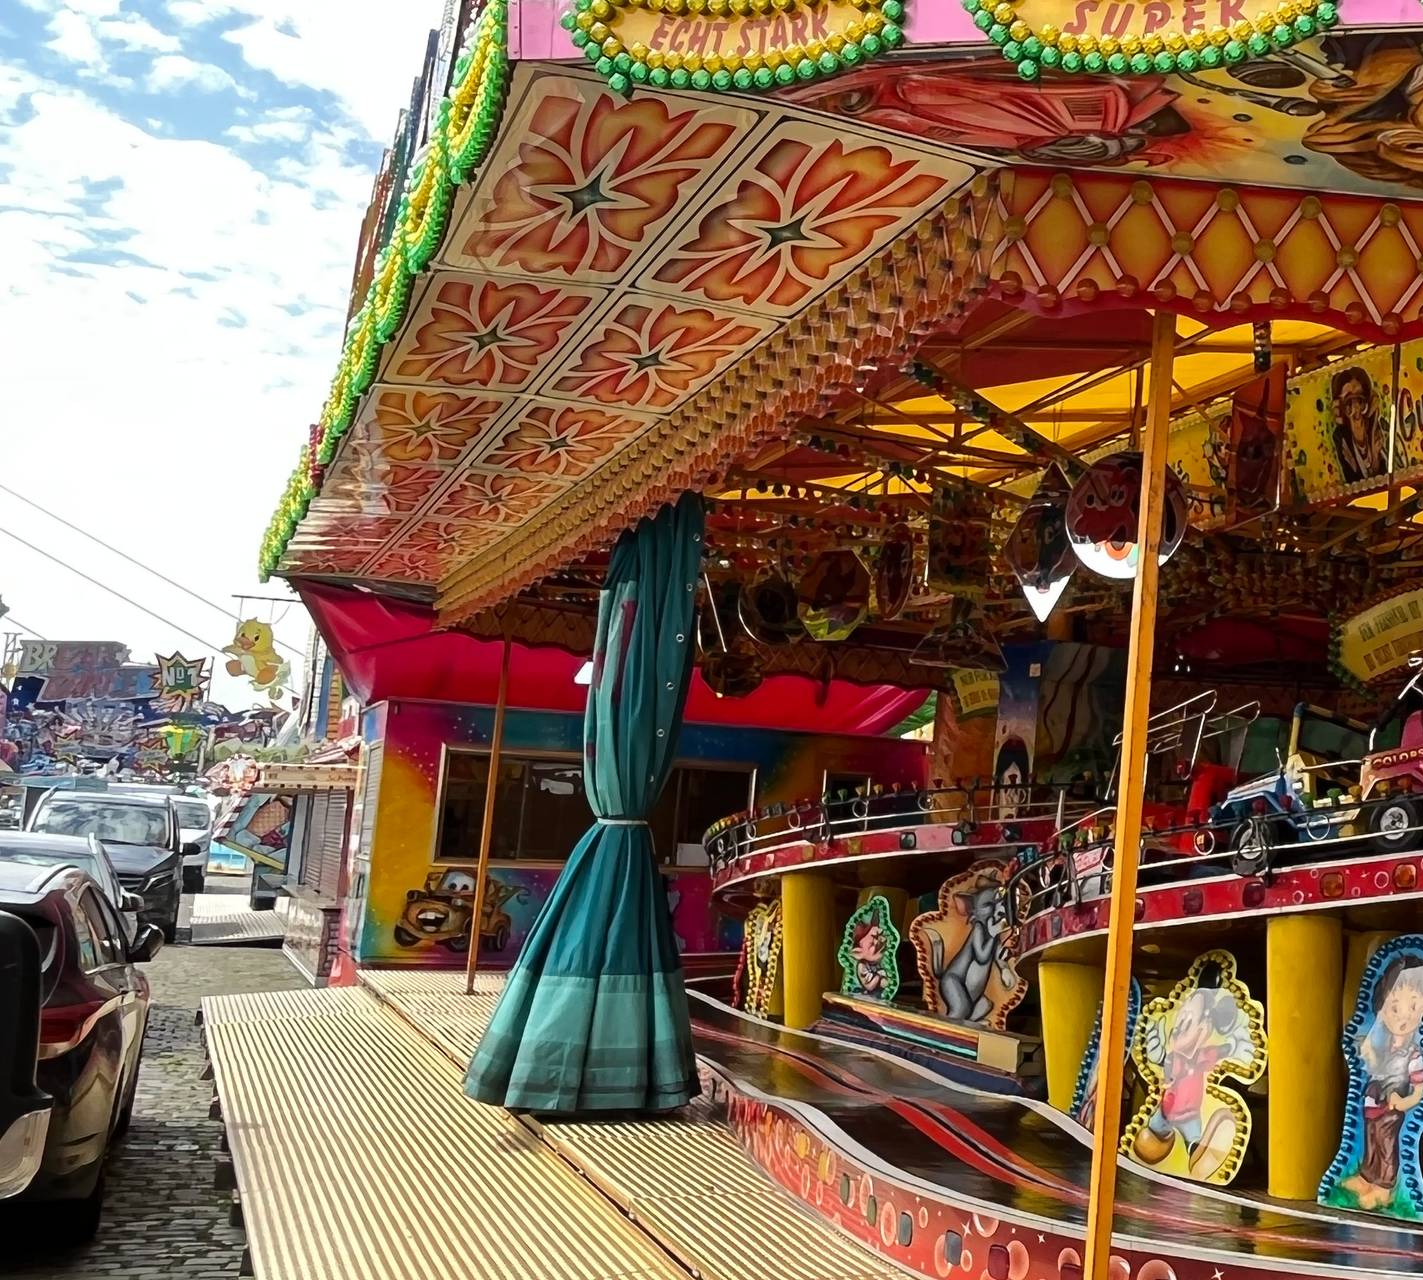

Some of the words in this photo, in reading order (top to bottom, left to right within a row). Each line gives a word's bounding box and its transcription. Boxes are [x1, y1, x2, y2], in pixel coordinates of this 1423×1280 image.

[649, 15, 731, 55] ECHT
[736, 4, 829, 56] STARK
[1063, 0, 1252, 37] SUPER
